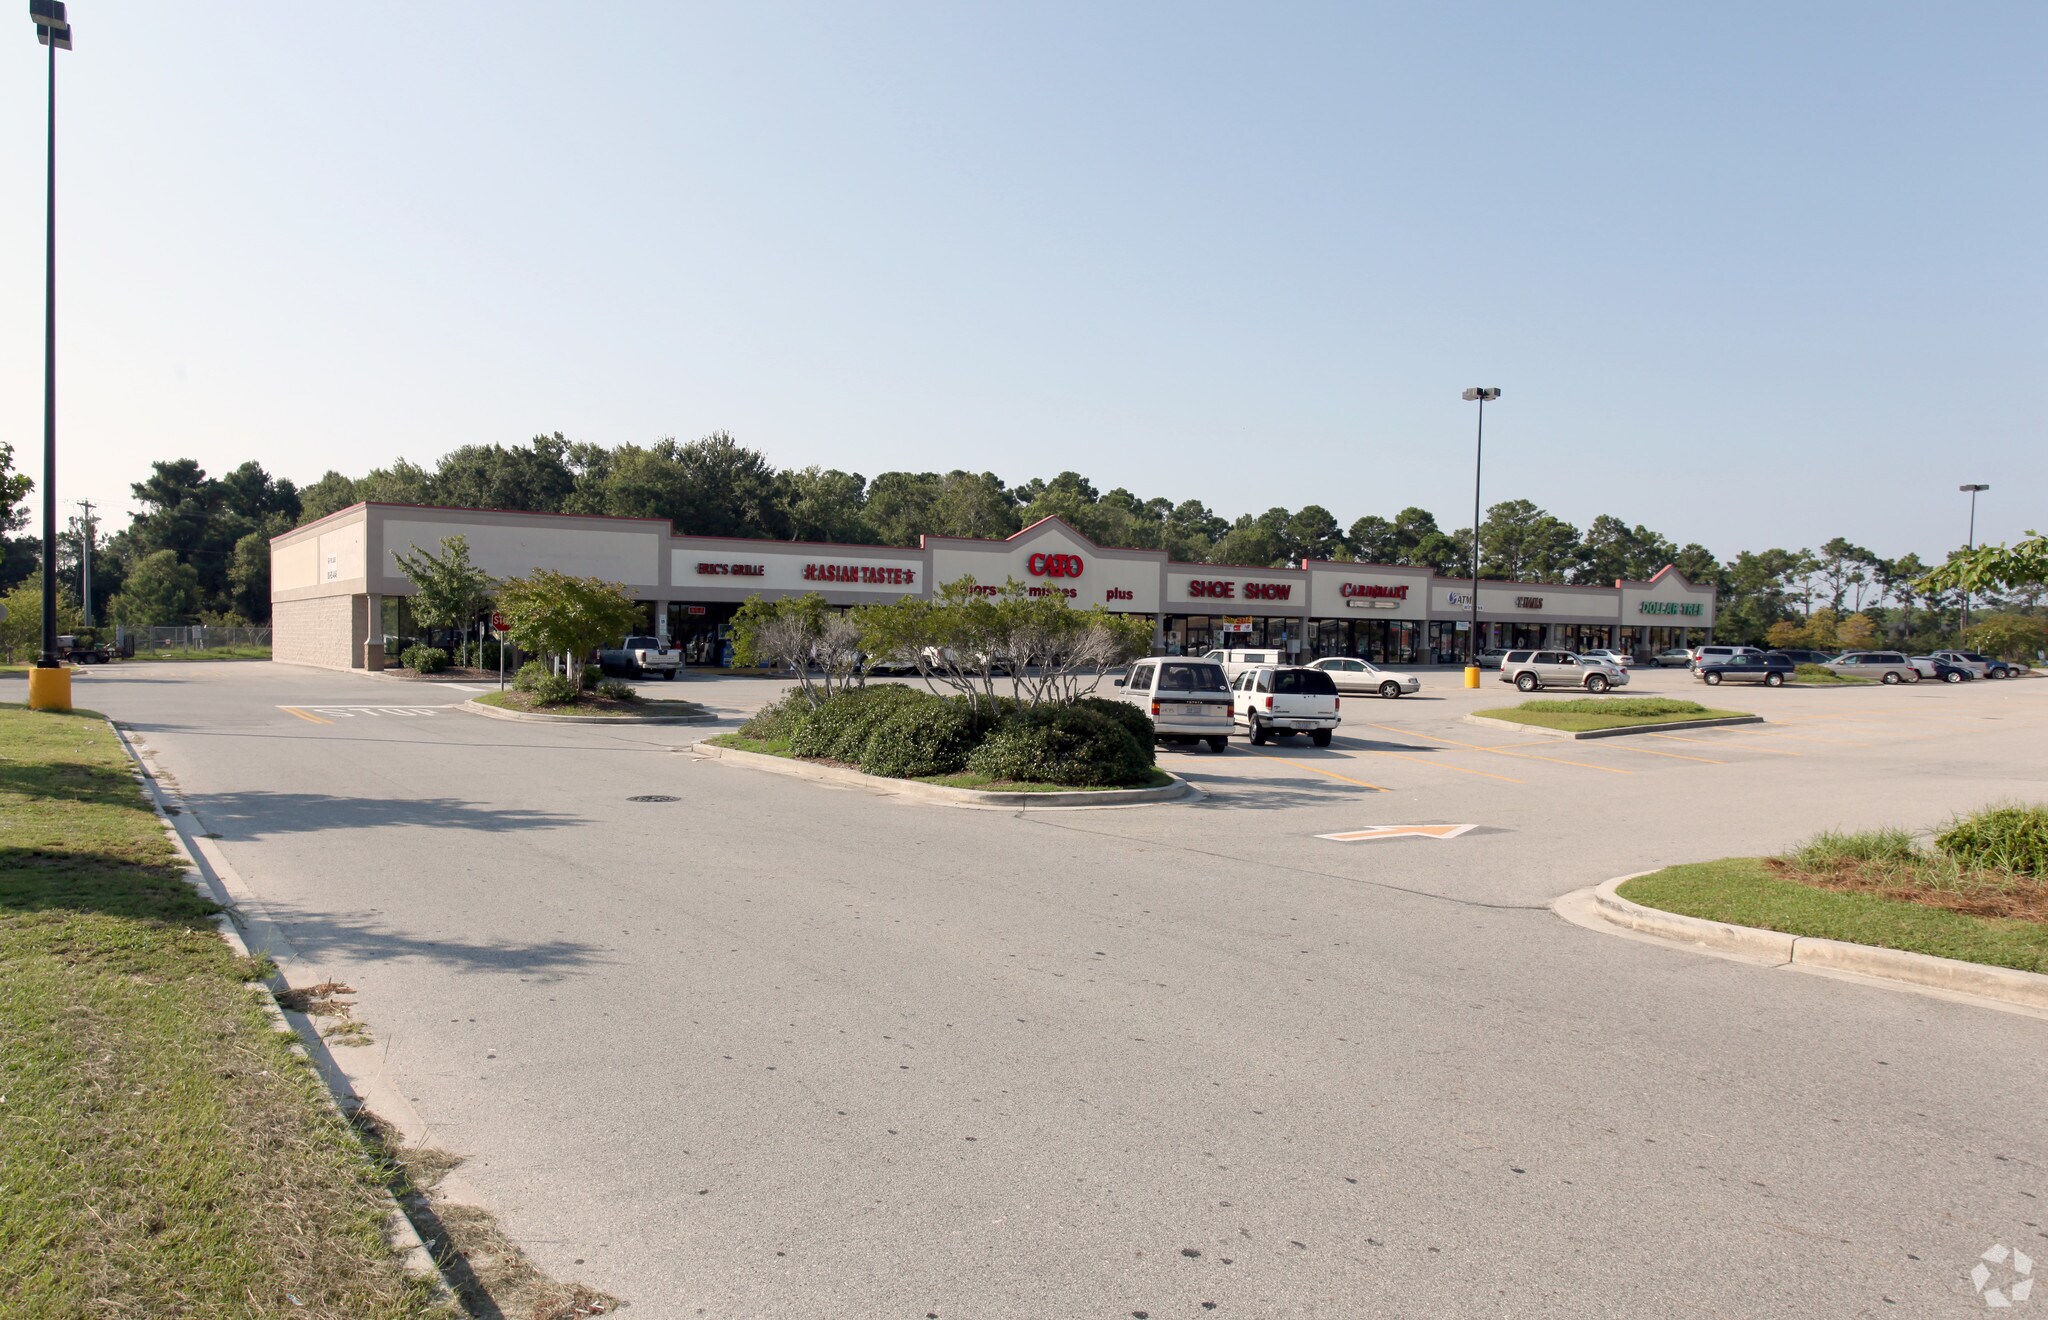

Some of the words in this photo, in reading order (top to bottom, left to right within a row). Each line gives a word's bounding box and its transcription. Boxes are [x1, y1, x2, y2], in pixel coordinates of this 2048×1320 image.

[697, 562, 729, 576] ERIC'S
[731, 563, 765, 577] GRILLE
[1028, 552, 1084, 578] CATO
[818, 564, 859, 583] ASIAN
[861, 566, 903, 585] TASTE
[1028, 584, 1078, 599] mises
[1106, 587, 1134, 602] plus
[1188, 579, 1235, 599] SHOE
[1243, 581, 1292, 601] SHOW
[1640, 601, 1679, 615] DOLLAR
[1680, 603, 1704, 616] TREE
